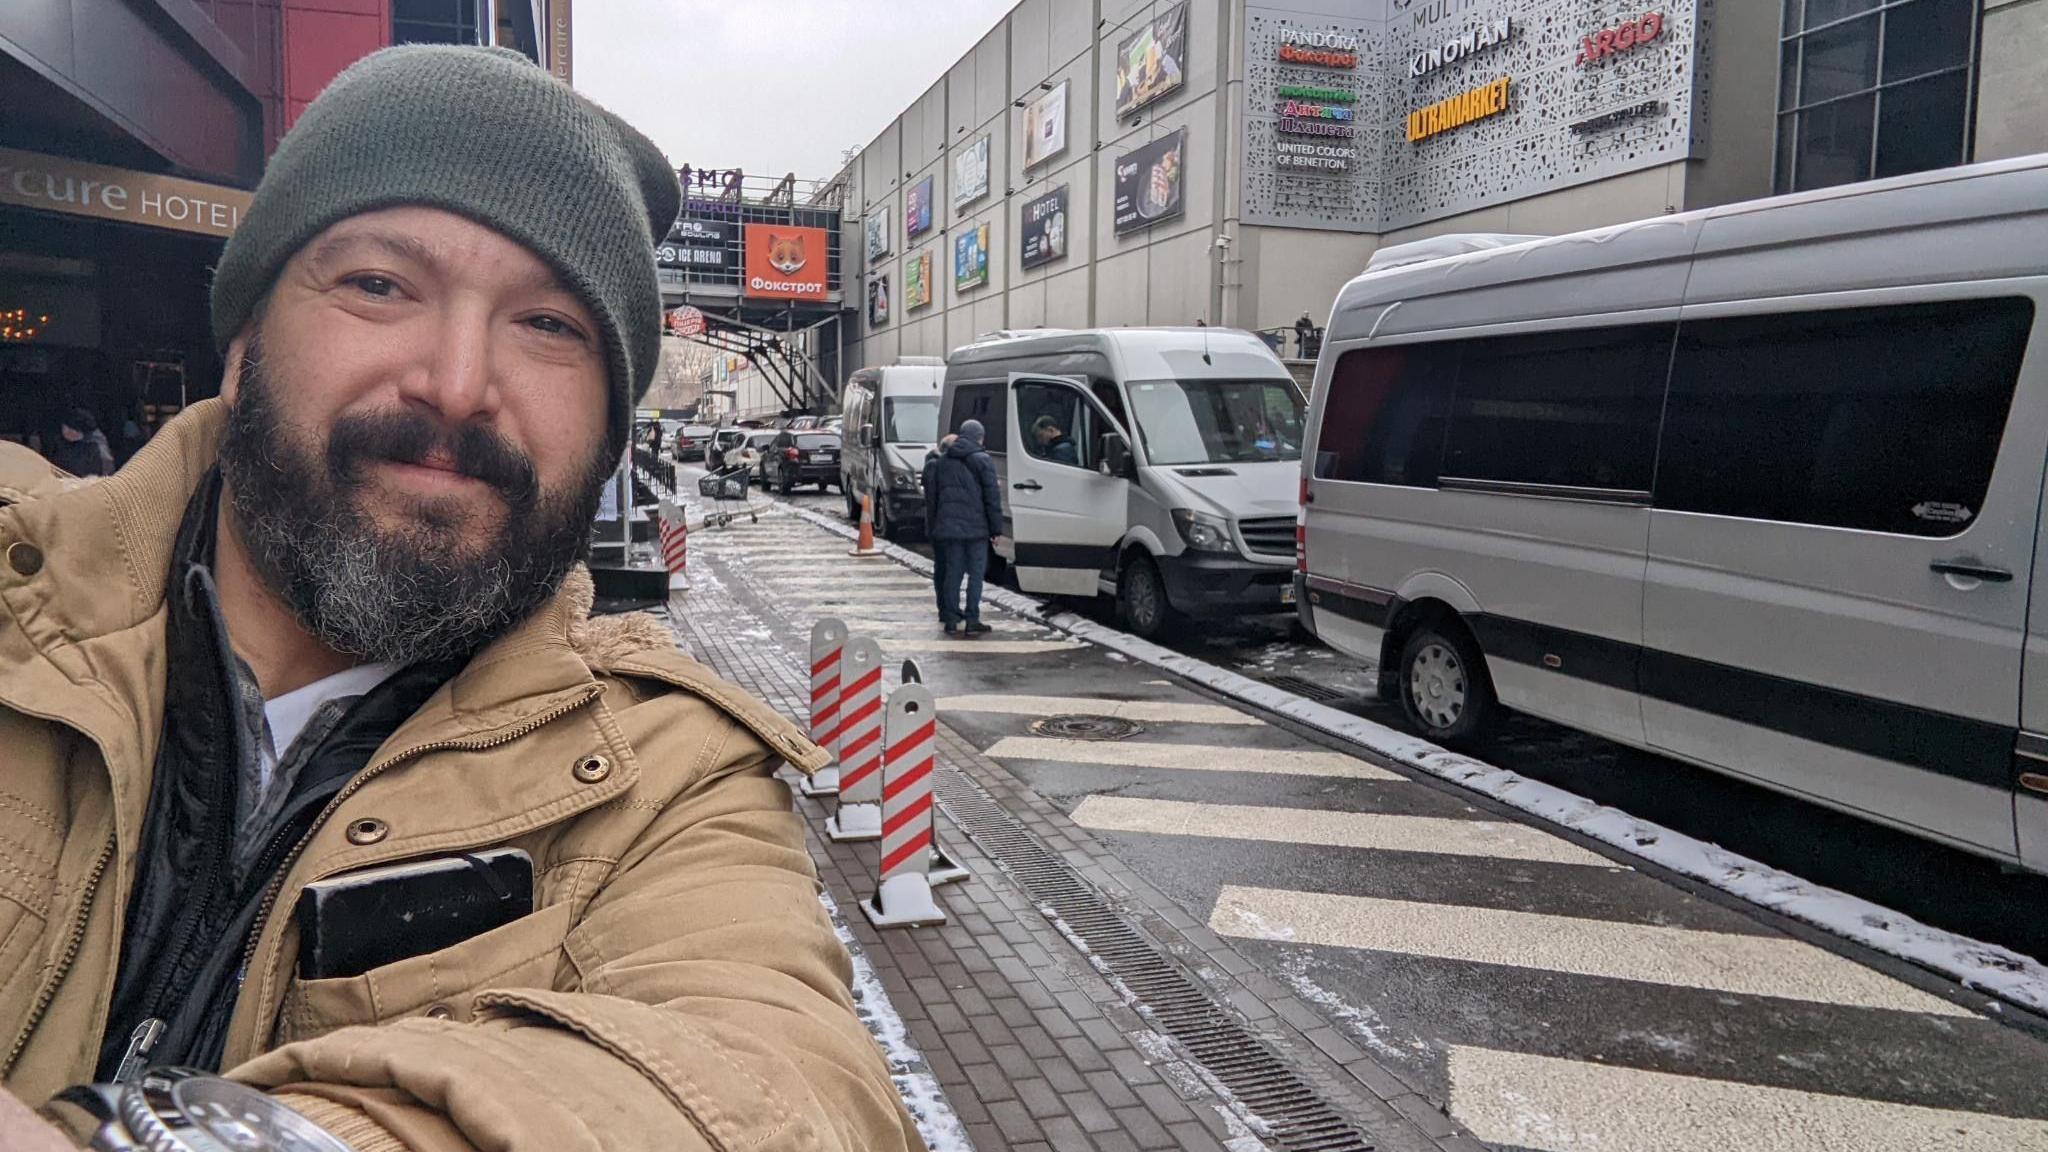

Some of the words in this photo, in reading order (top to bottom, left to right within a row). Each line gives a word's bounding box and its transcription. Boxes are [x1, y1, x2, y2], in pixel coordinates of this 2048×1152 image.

[1280, 28, 1359, 50] PANDORA
[1409, 16, 1513, 78] KINOMAN
[1574, 10, 1664, 66] ARGO
[1407, 75, 1512, 142] ULTRAMARKET
[1277, 143, 1315, 155] UNITED
[1316, 146, 1356, 158] COLORS
[1277, 155, 1292, 165] OF
[1033, 197, 1060, 222] HOTEL
[678, 248, 692, 263] ICE
[694, 249, 722, 264] ARENA
[751, 277, 823, 294] Фокстрот
